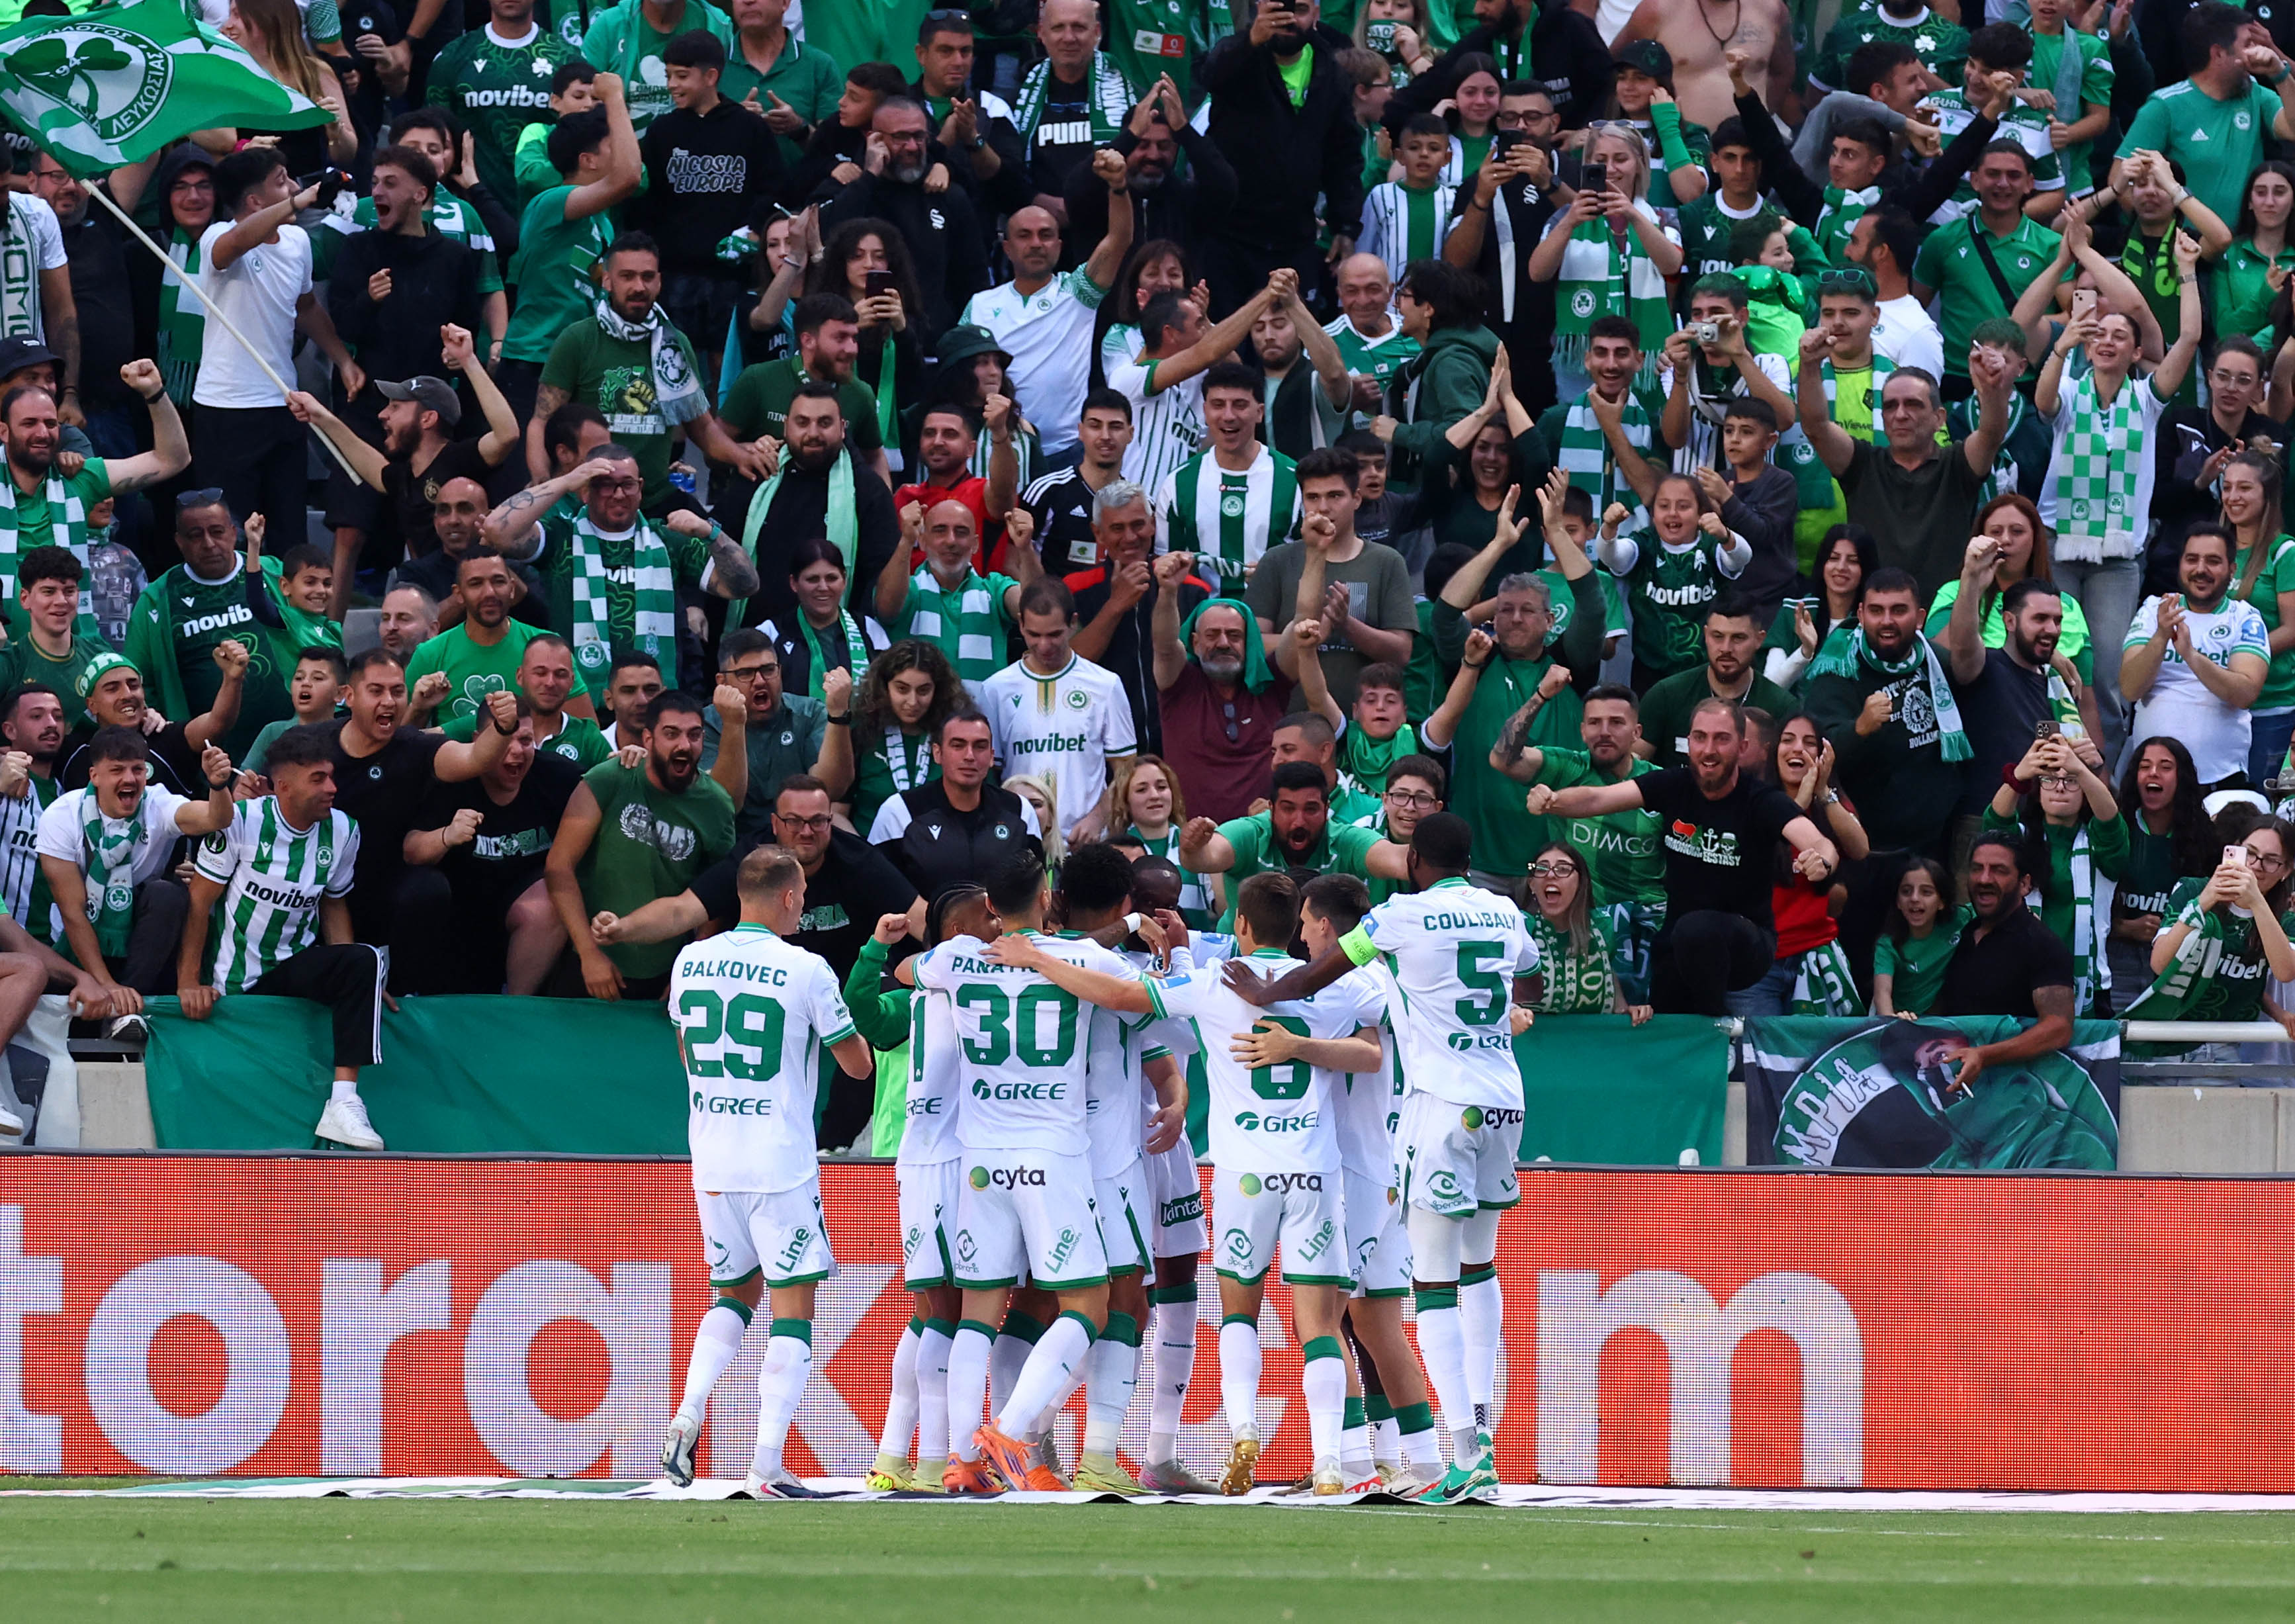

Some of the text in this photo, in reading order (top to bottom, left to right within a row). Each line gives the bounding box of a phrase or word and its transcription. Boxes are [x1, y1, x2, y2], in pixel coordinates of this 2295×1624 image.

[465, 85, 553, 109] novibe
[1038, 120, 1092, 147] PUM
[667, 156, 746, 175] NICOSIA
[674, 173, 745, 193] EUROPE
[183, 603, 253, 639] novib
[1012, 732, 1087, 754] novibet
[244, 880, 323, 911] novibet
[1423, 912, 1516, 931] COULIBALY
[682, 960, 788, 987] BALKOVEC
[1455, 940, 1508, 1026] 5
[679, 989, 786, 1082] 29
[956, 983, 1079, 1067] 30
[994, 1083, 1067, 1100] GREE
[708, 1096, 772, 1116] GREE
[905, 1097, 943, 1119] REE
[1263, 1110, 1320, 1133] GRE
[993, 1165, 1046, 1191] cyta
[1264, 1173, 1323, 1195] cyta
[776, 1228, 810, 1273] Line
[1045, 1228, 1075, 1275] Line
[1298, 1219, 1334, 1263] Line
